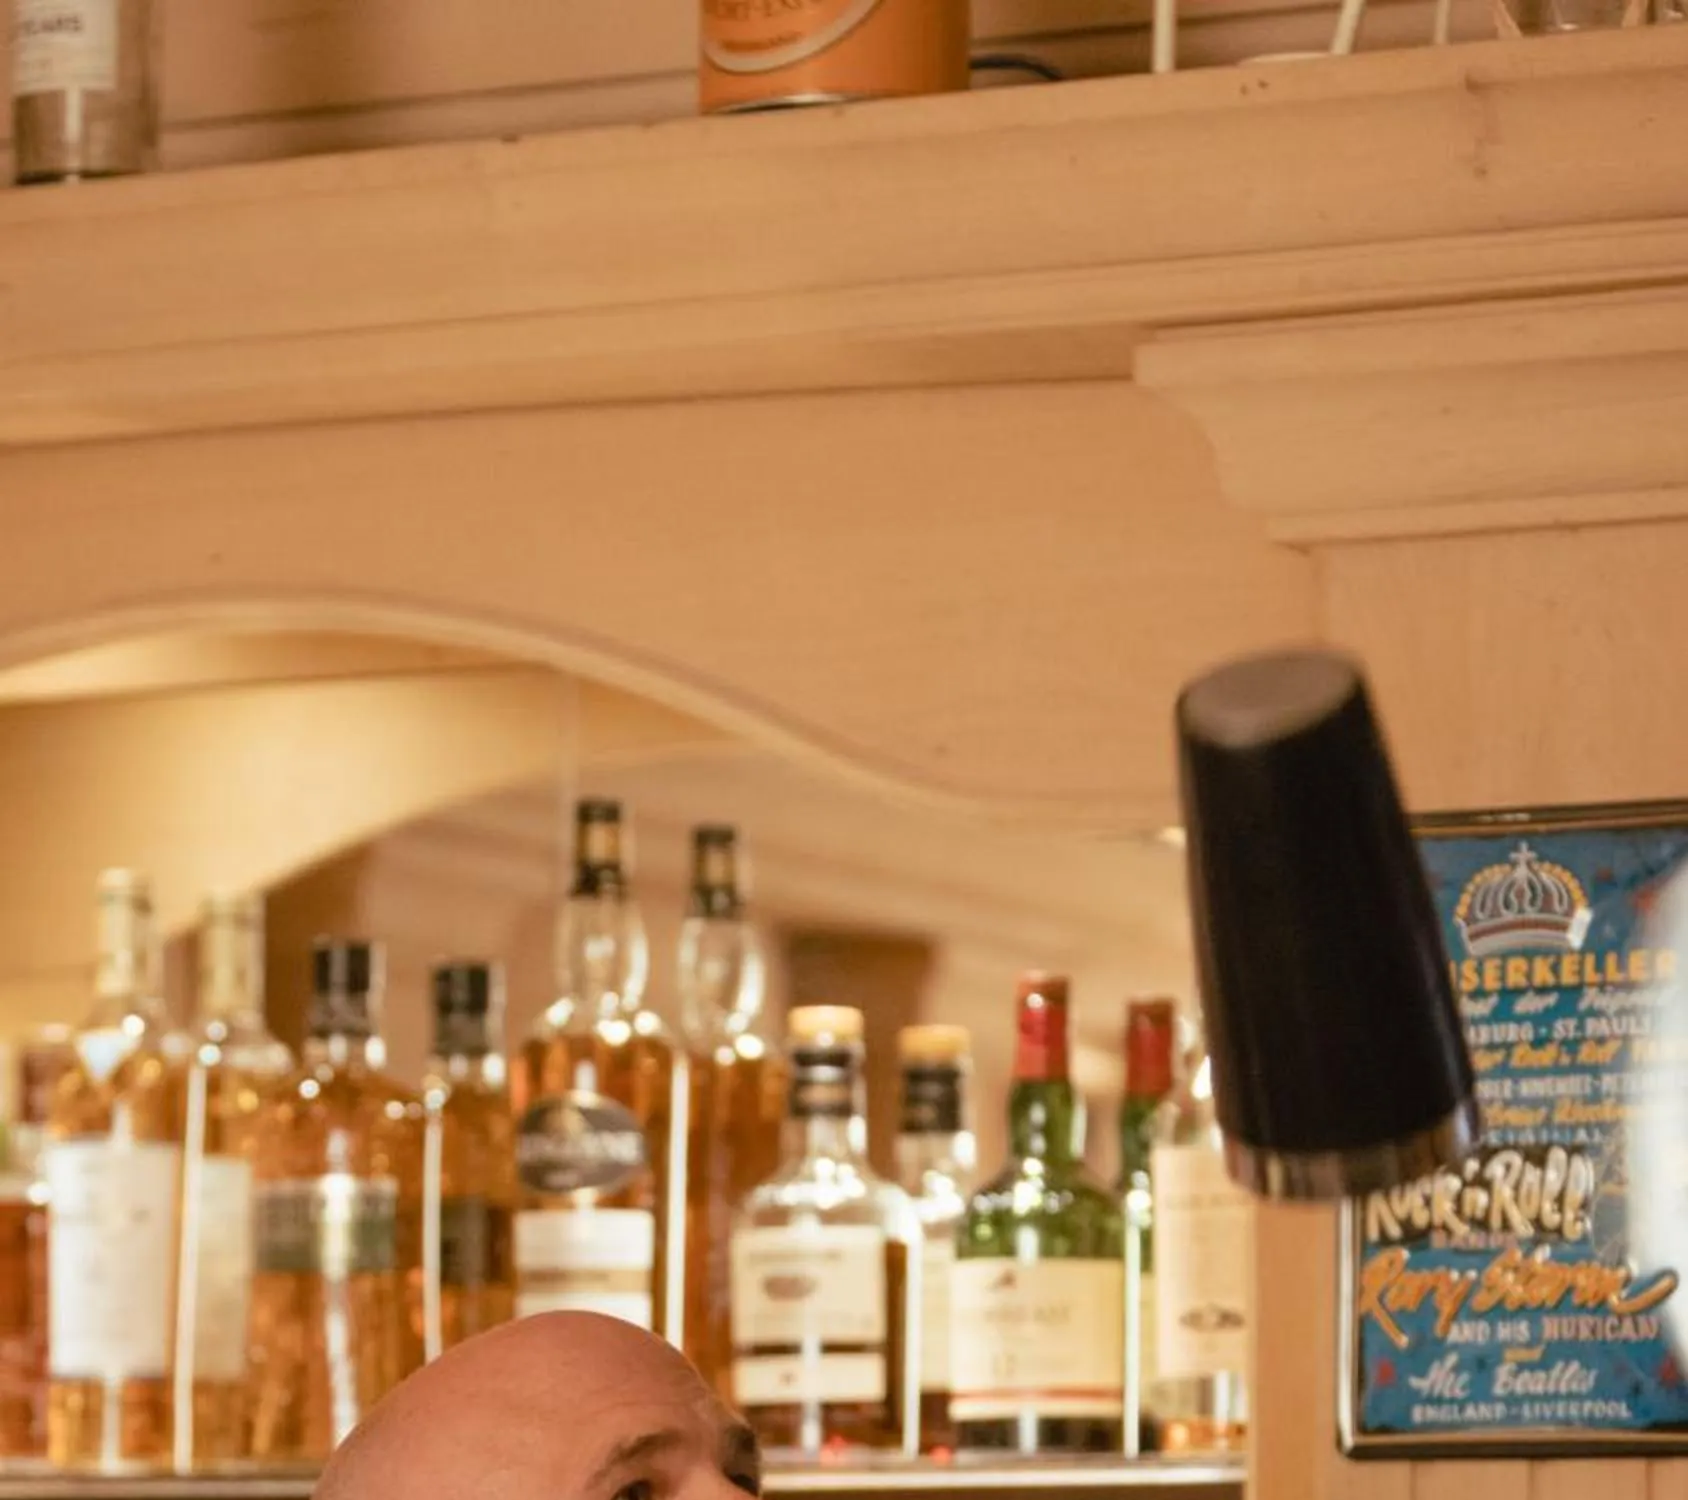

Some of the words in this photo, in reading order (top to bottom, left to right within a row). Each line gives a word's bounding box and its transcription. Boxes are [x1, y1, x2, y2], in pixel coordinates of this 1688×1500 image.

[1447, 949, 1678, 993] ISERKELLER
[1447, 1321, 1491, 1344] AND
[1496, 1319, 1531, 1342] HIS
